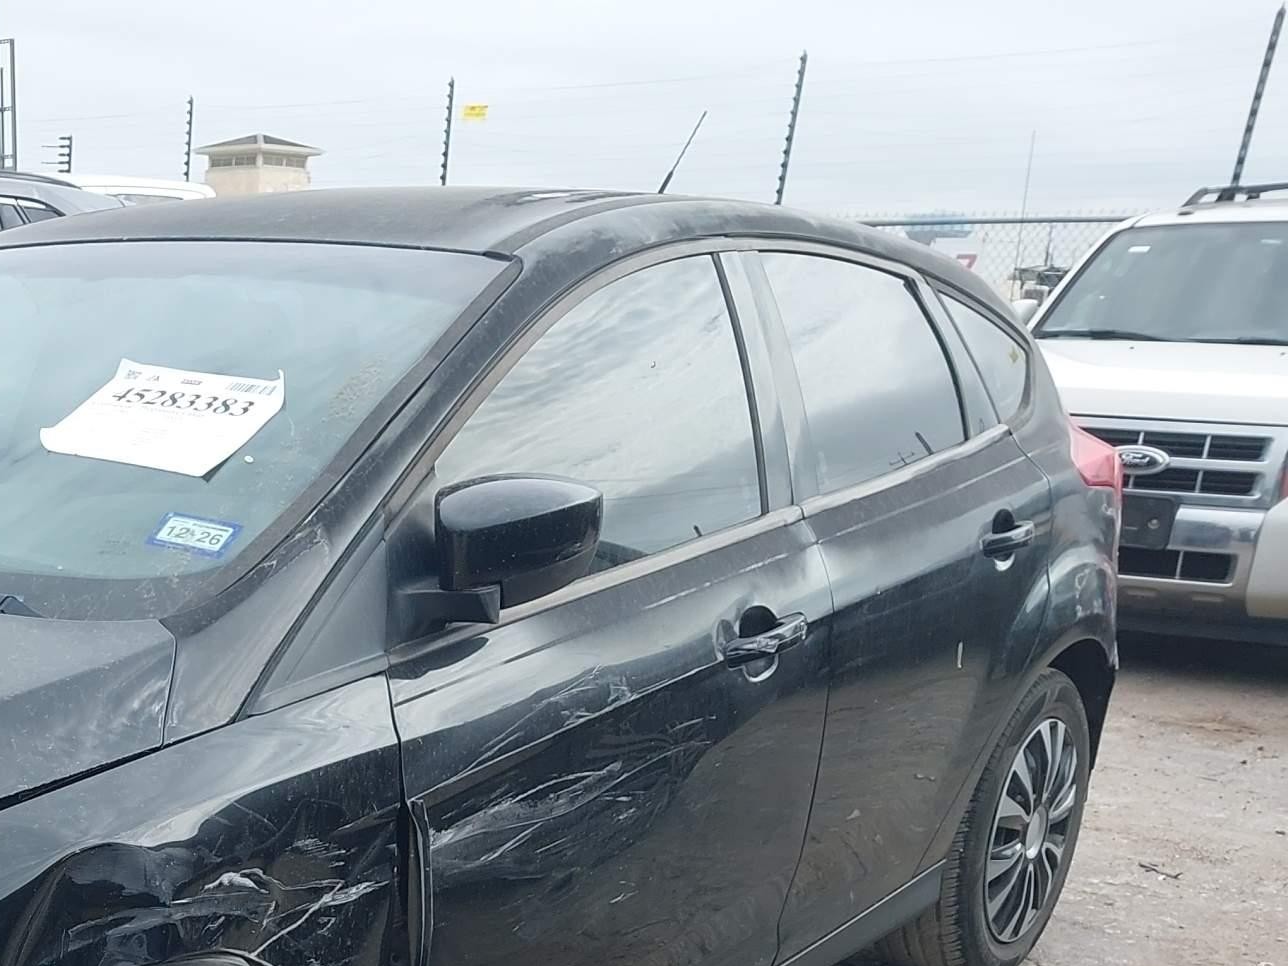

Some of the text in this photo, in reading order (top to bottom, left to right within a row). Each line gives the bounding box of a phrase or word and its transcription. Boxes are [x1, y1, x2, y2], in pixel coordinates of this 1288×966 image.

[111, 387, 256, 417] 45283383
[166, 525, 190, 539] 12
[195, 531, 224, 546] 26
